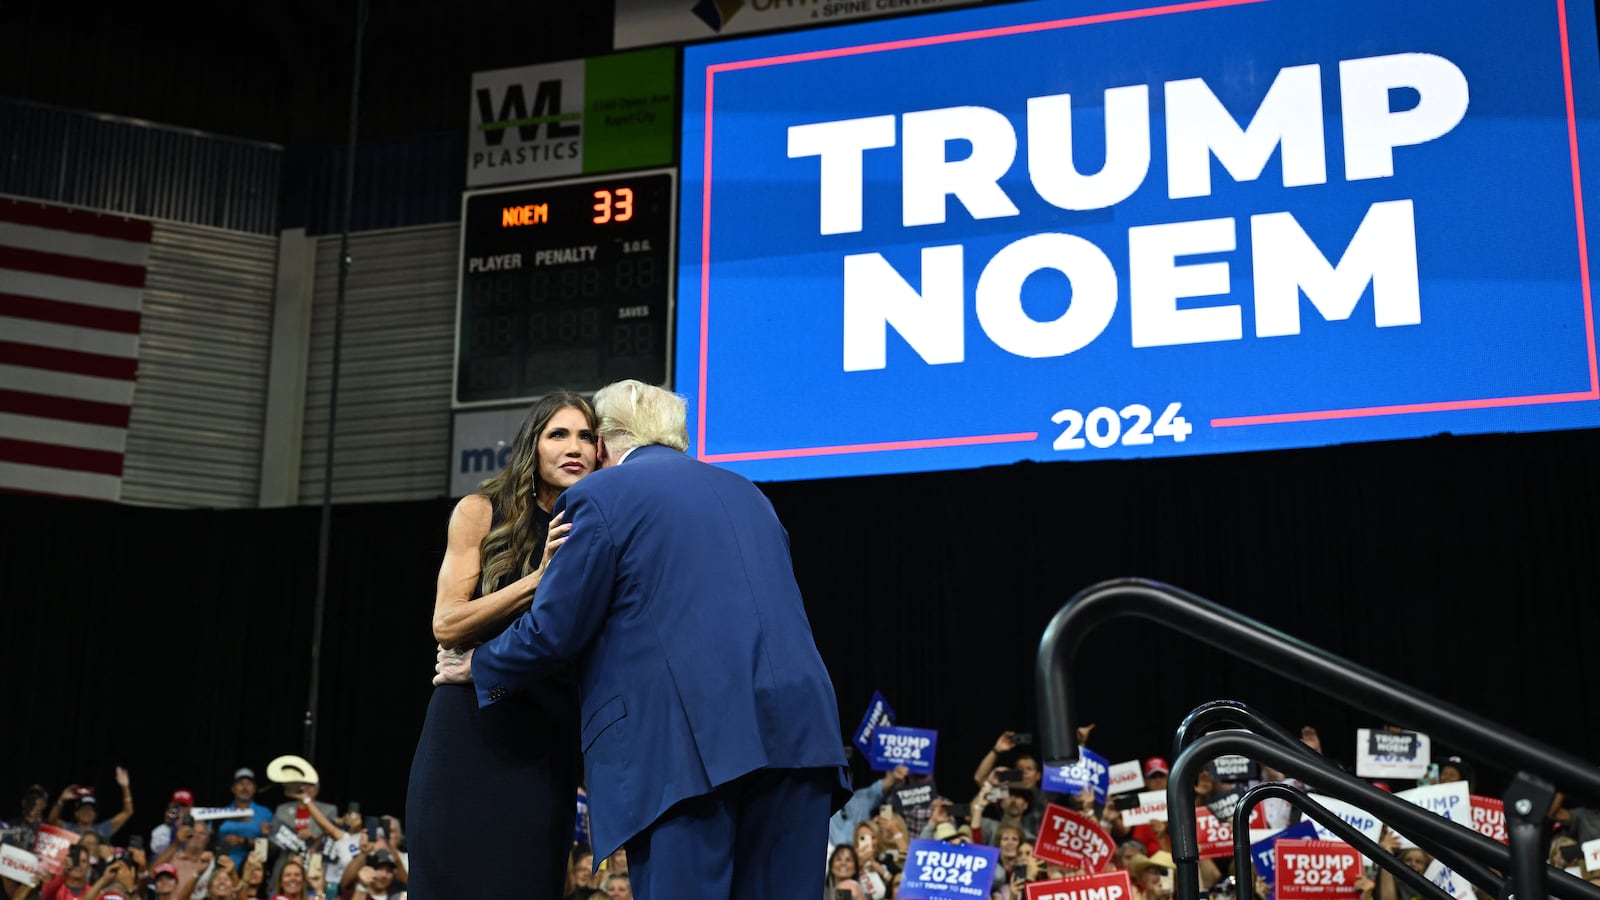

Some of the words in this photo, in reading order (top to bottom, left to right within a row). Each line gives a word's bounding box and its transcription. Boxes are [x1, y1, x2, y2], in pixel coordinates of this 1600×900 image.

[823, 1, 873, 17] SPINE
[476, 79, 580, 147] WL
[787, 52, 1470, 235] TRUMP
[473, 141, 579, 169] PLASTICS
[501, 202, 549, 229] NOEM
[592, 187, 634, 226] 33
[470, 253, 522, 273] PLAYER
[535, 246, 598, 267] PENALTY
[843, 199, 1422, 372] NOEM
[619, 305, 650, 319] SAVES
[1051, 402, 1193, 451] 2024
[877, 733, 931, 750] TRUMP
[1375, 734, 1413, 745] TRUMP
[887, 744, 919, 760] 2024
[1058, 765, 1100, 786] 2024
[896, 785, 932, 801] TRUMP
[1051, 815, 1109, 858] TRUMP
[1056, 832, 1102, 866] 2024
[915, 850, 988, 873] TRUMP
[1283, 853, 1355, 871] TRUMP
[919, 866, 974, 887] 2024
[1293, 868, 1346, 886] 2024
